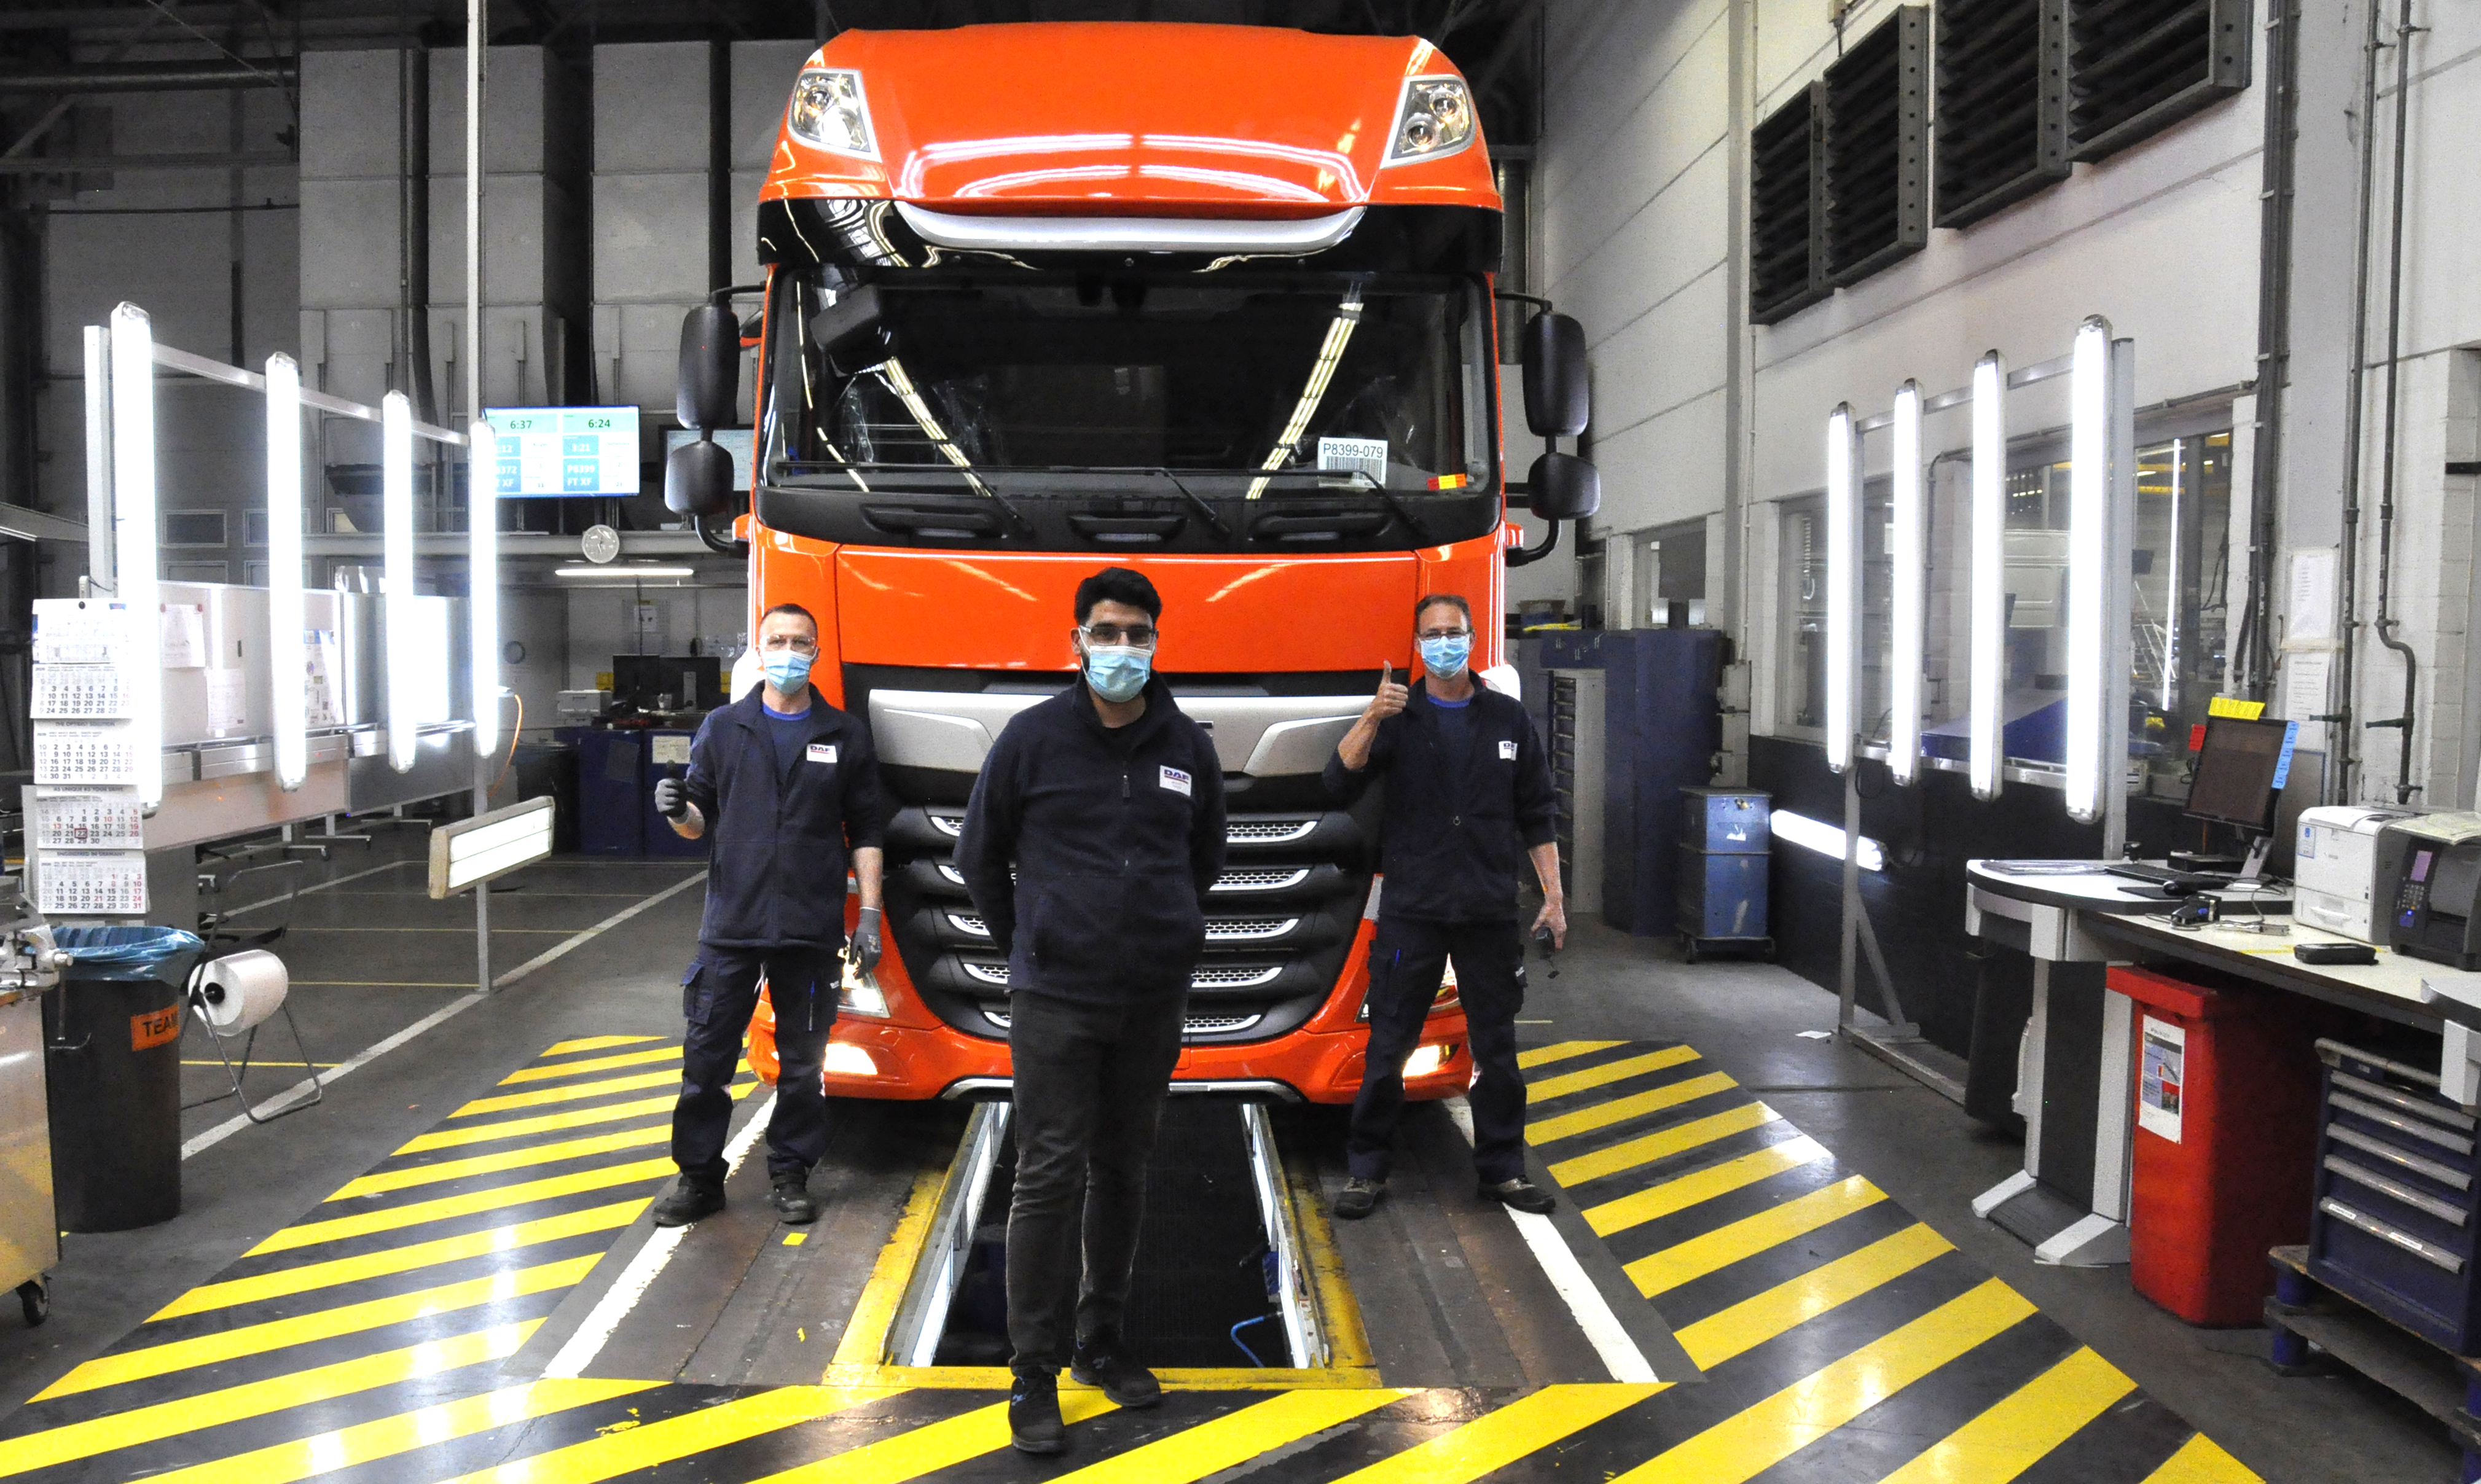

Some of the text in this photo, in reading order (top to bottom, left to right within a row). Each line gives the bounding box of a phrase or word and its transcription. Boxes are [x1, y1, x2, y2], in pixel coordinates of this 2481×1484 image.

[510, 420, 532, 429] 6:37
[588, 419, 610, 428] 6:24
[1323, 443, 1382, 458] P8399-079
[1164, 769, 1189, 780] DAF
